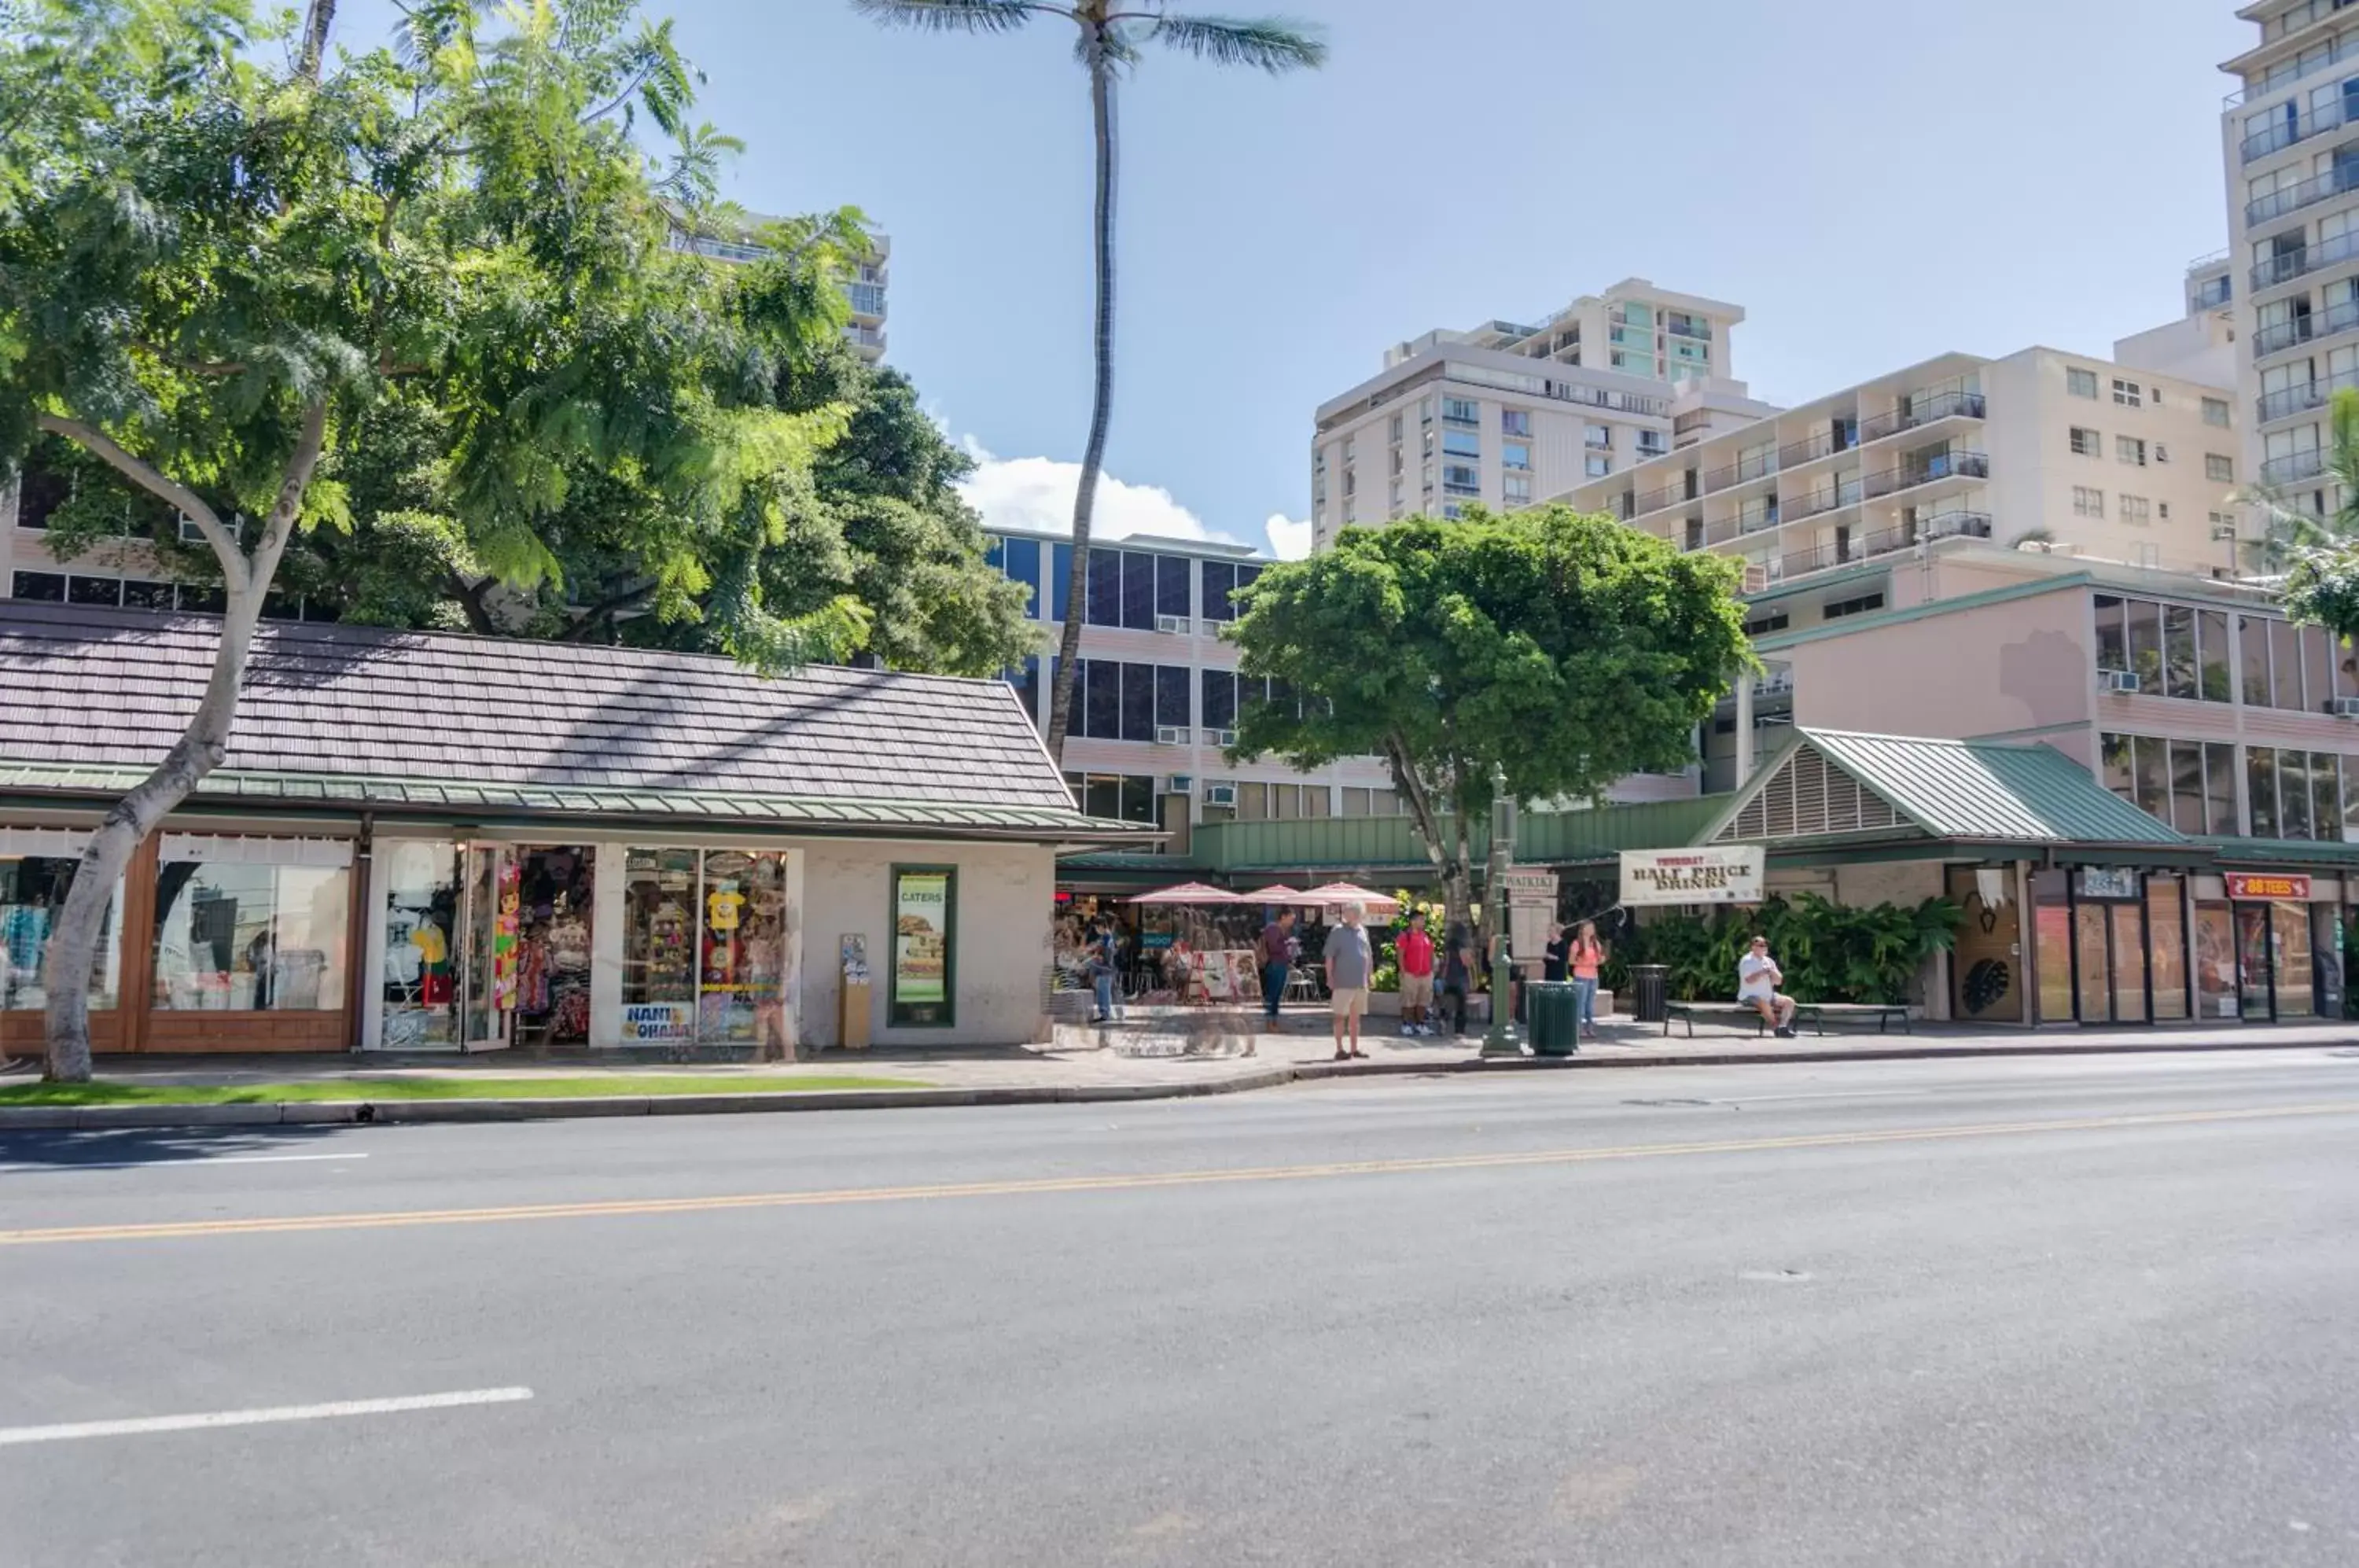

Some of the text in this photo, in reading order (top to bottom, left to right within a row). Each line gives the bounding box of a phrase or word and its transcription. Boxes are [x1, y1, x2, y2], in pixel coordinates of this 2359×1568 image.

[1632, 865, 1750, 881] HALF PRICE
[1655, 878, 1728, 891] DRINKS
[901, 892, 942, 903] CATERS
